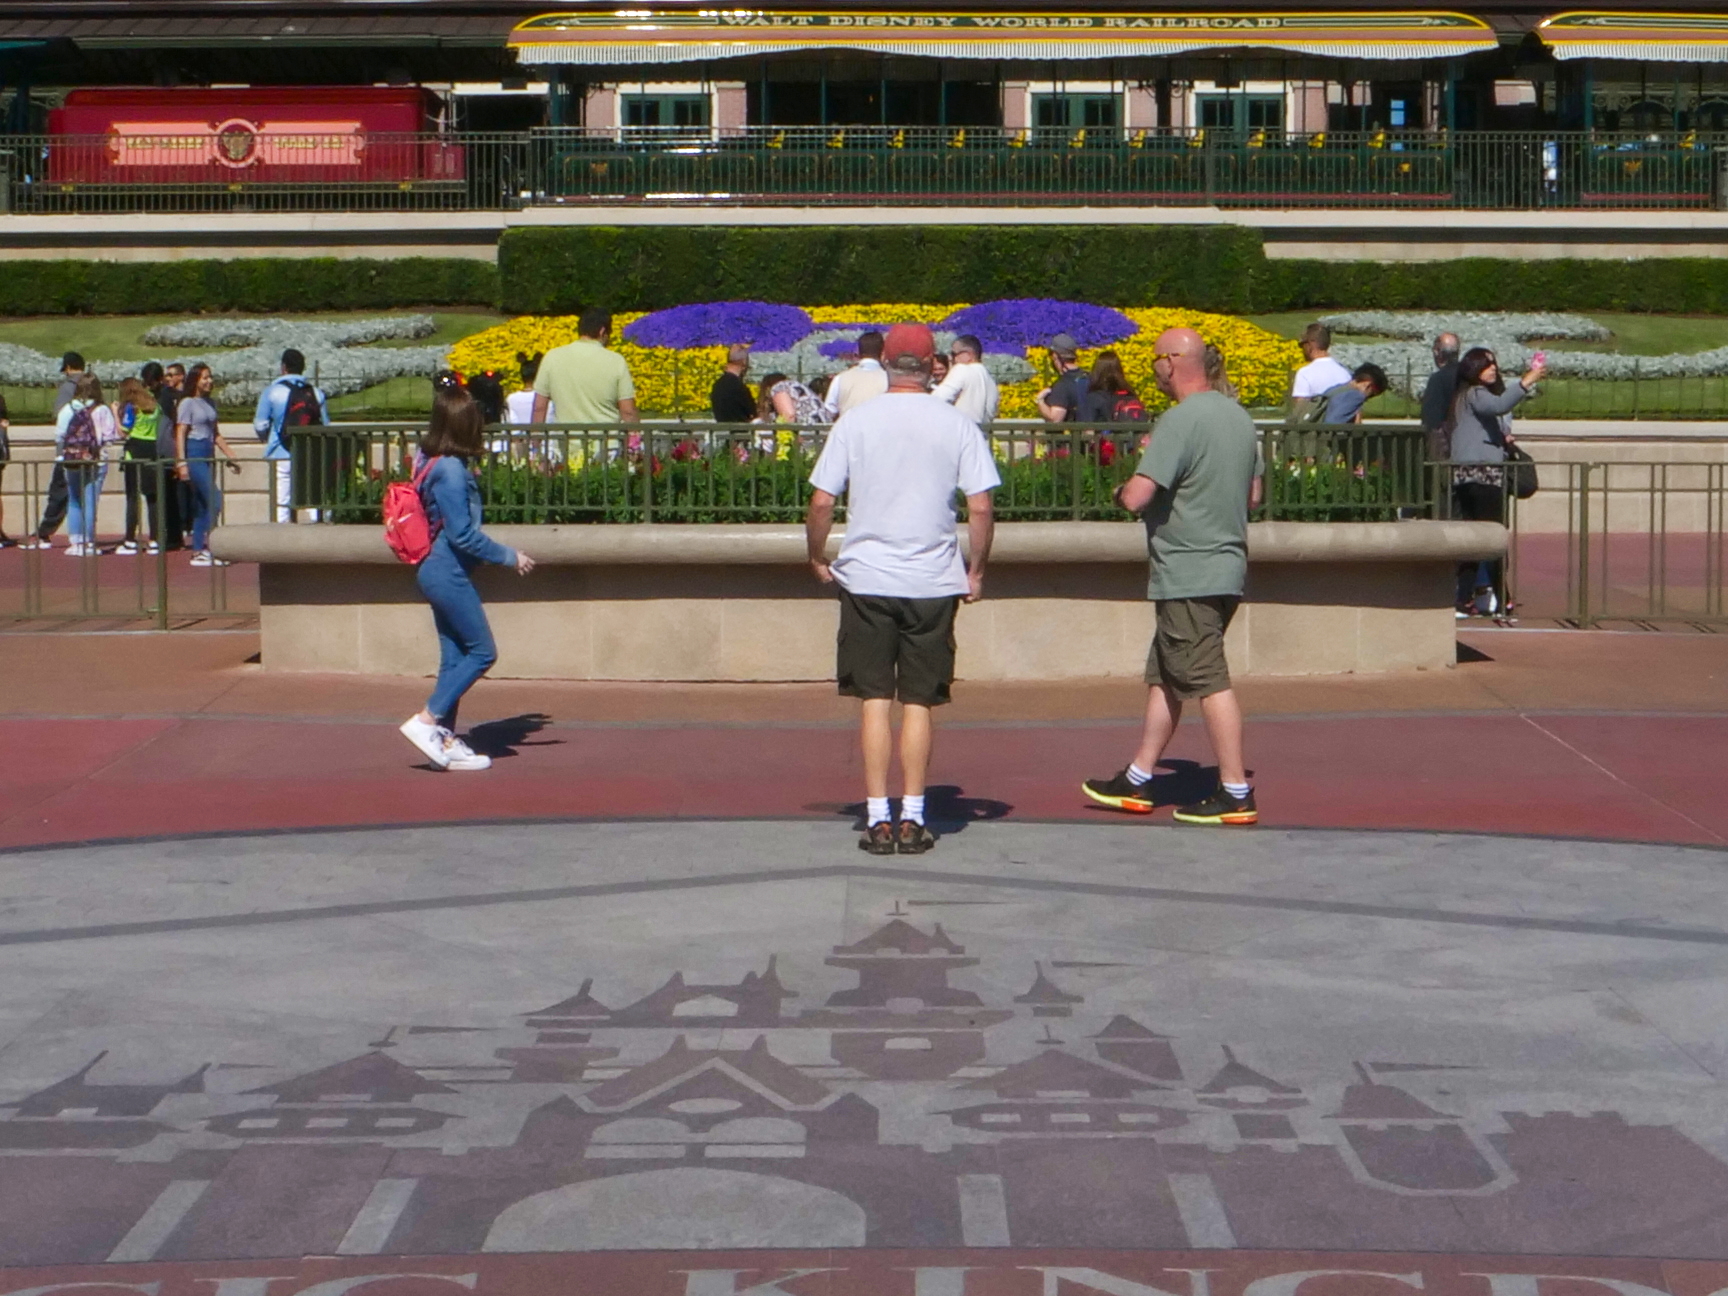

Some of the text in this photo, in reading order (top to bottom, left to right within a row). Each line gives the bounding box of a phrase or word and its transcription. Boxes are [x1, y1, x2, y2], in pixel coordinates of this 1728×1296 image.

[723, 15, 1279, 28] WALT DISNEY WORLD RAILROAD
